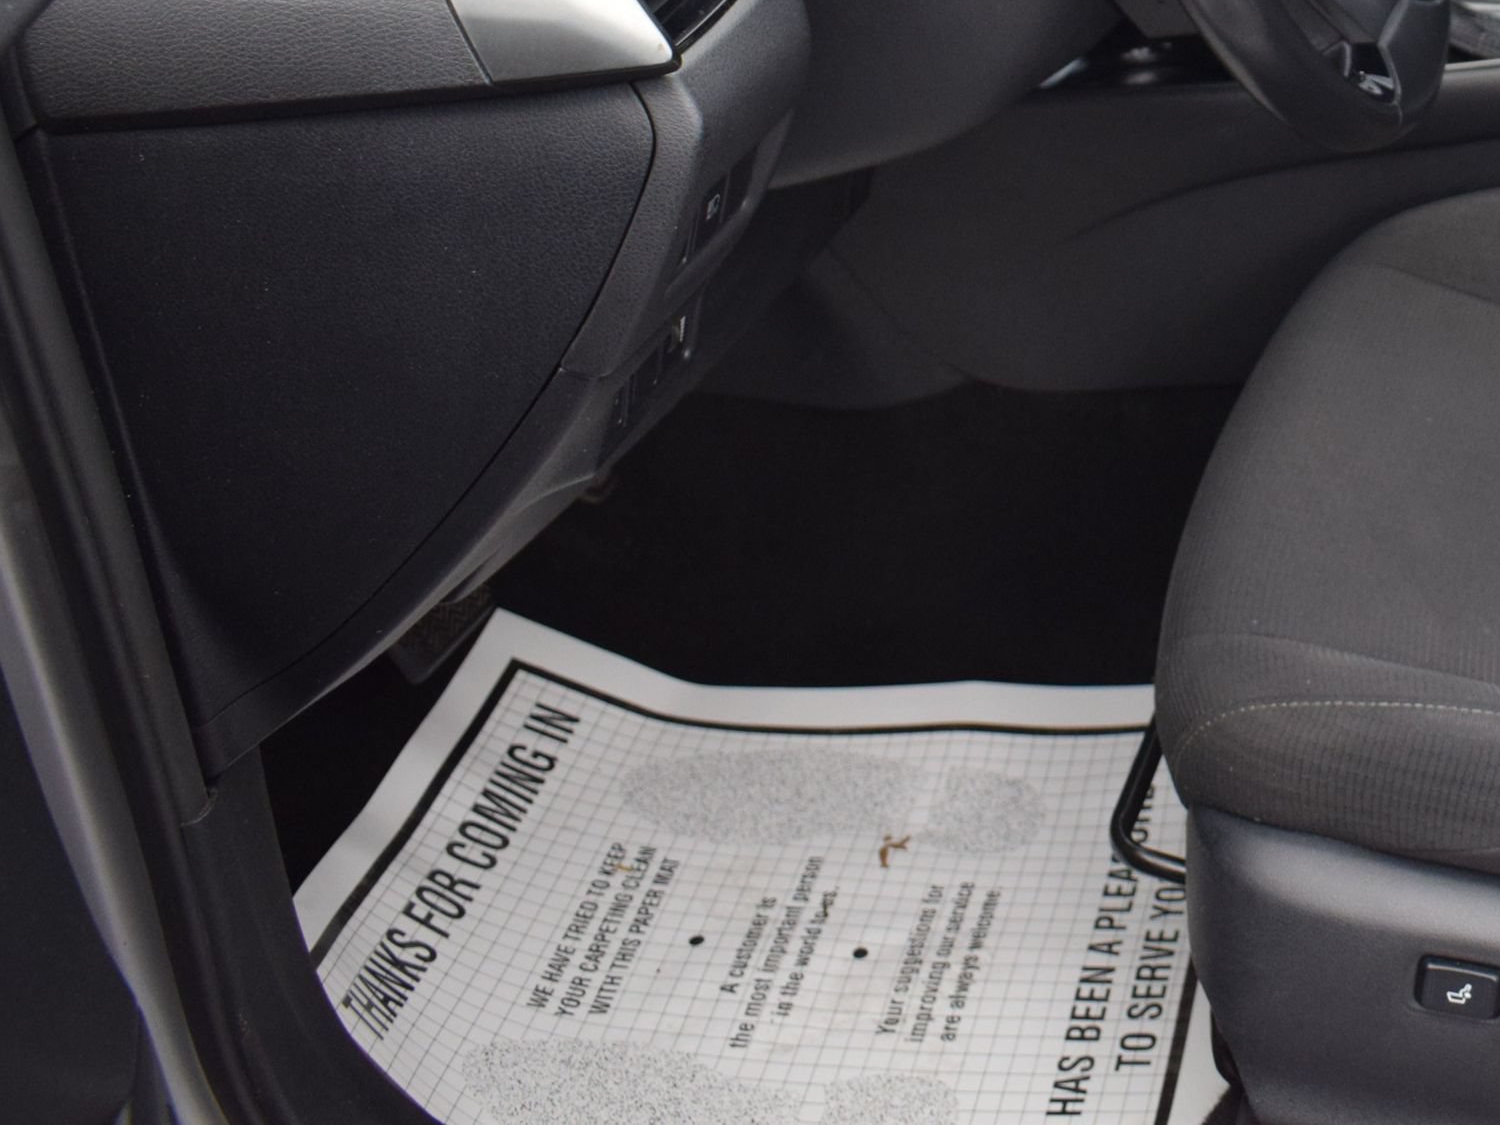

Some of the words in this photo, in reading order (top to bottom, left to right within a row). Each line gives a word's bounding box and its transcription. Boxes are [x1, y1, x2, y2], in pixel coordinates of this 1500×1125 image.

[342, 928, 438, 1041] THANKS
[401, 868, 482, 939] FOR
[446, 744, 558, 871] COMING
[524, 702, 580, 744] IN
[598, 842, 627, 877] KEEP
[792, 855, 824, 903] person
[586, 878, 611, 897] TO
[761, 895, 777, 910] is
[1149, 877, 1187, 919] YO
[554, 976, 592, 1017] YOUR
[579, 892, 634, 973] CARPETING
[621, 846, 657, 891] CLEAN
[562, 900, 599, 942] TRIED
[588, 974, 623, 1016] WITH
[609, 937, 642, 970] THIS
[628, 889, 665, 935] PAPER
[652, 856, 680, 887] MAT
[729, 904, 769, 979] customer
[757, 905, 802, 973] important
[541, 944, 576, 983] HAVE
[795, 927, 822, 966] world
[875, 999, 904, 1035] Your
[894, 907, 936, 993] suggestions
[922, 884, 944, 904] for
[904, 960, 951, 1043] improving
[936, 932, 954, 957] our
[946, 881, 975, 933] service
[1088, 939, 1123, 956] A
[719, 982, 740, 995] A
[781, 971, 804, 997] the
[948, 954, 980, 1010] always
[1127, 929, 1180, 1020] SERVE
[526, 984, 554, 1009] WE
[744, 977, 772, 1017] most
[772, 1002, 793, 1018] in
[1065, 966, 1116, 1043] BEEN
[729, 1022, 755, 1049] the
[940, 1014, 961, 1042] are
[1115, 1032, 1157, 1072] TO
[1046, 1055, 1095, 1117] HAS
